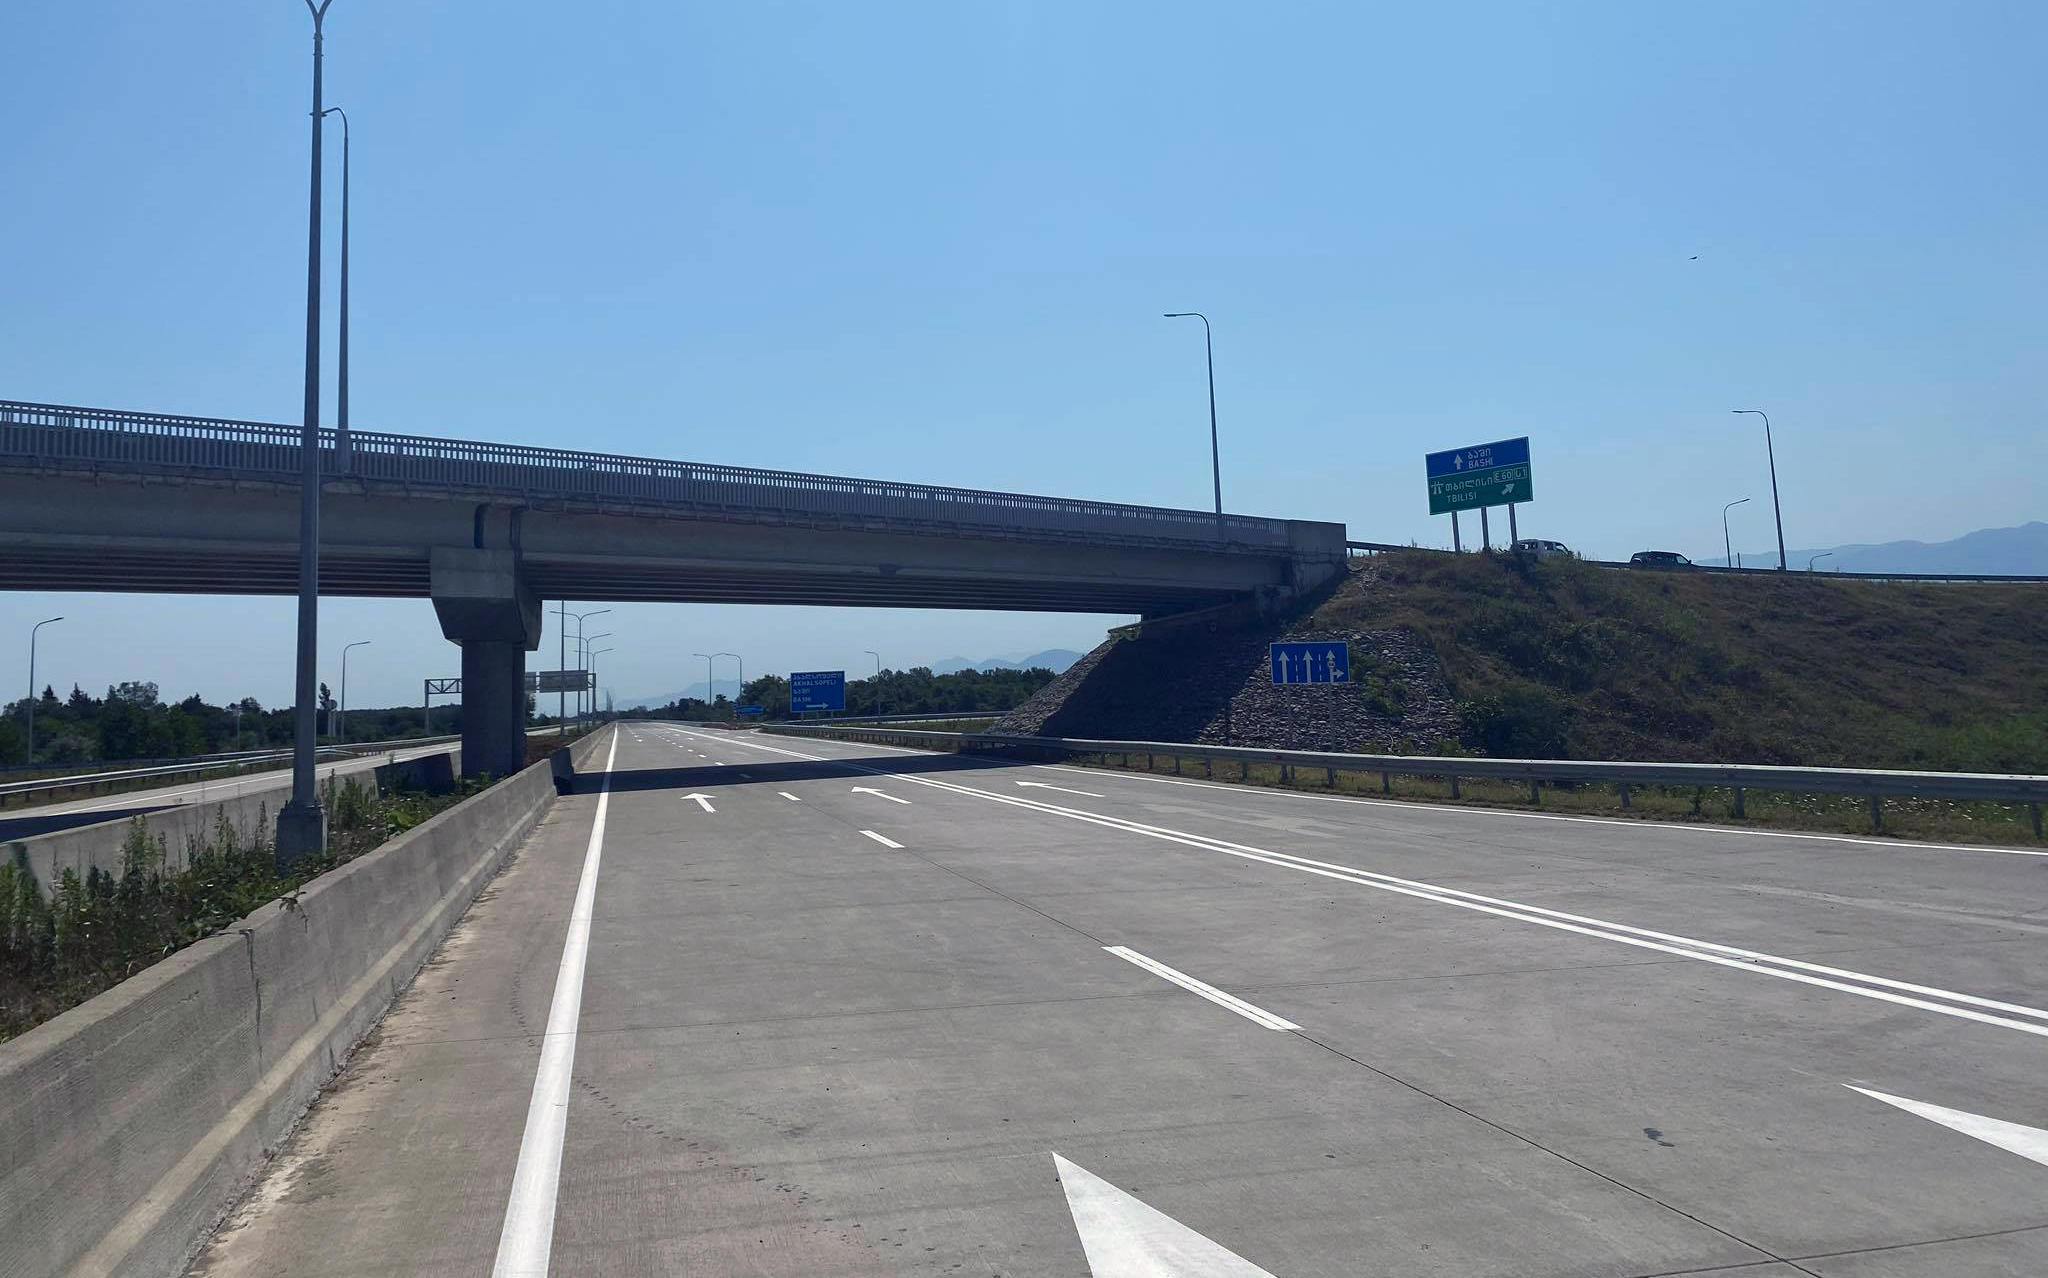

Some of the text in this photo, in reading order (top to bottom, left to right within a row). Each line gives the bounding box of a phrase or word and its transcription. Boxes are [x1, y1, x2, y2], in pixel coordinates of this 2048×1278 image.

[1467, 448, 1491, 460] ბაში
[1468, 457, 1494, 469] BASHI
[1445, 476, 1493, 492] თბილისი
[1446, 492, 1477, 504] TBILISI
